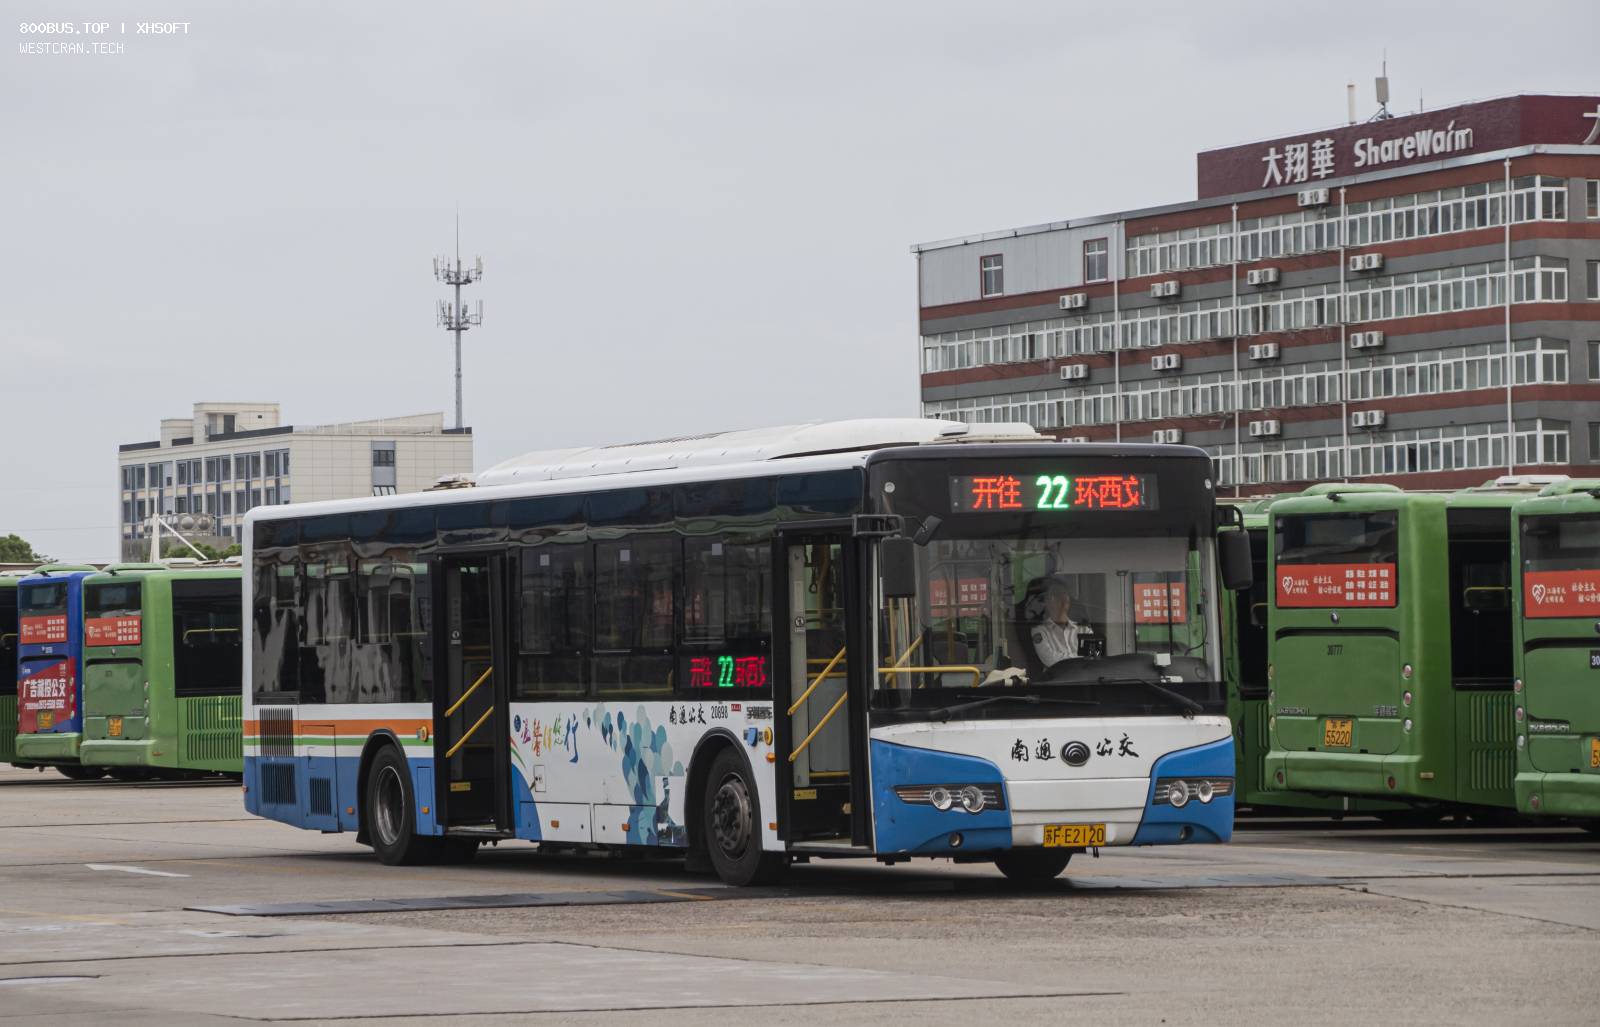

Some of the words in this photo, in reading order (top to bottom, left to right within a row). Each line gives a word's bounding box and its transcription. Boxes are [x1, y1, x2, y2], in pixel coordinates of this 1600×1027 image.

[1261, 137, 1336, 188] 大翔華
[1353, 120, 1474, 168] ShareWarm
[972, 475, 1022, 509] 开往
[1035, 475, 1070, 509] 22
[718, 656, 734, 687] 22
[1011, 738, 1056, 762] 南通
[1096, 732, 1139, 758] 公交
[1325, 730, 1350, 745] 55220
